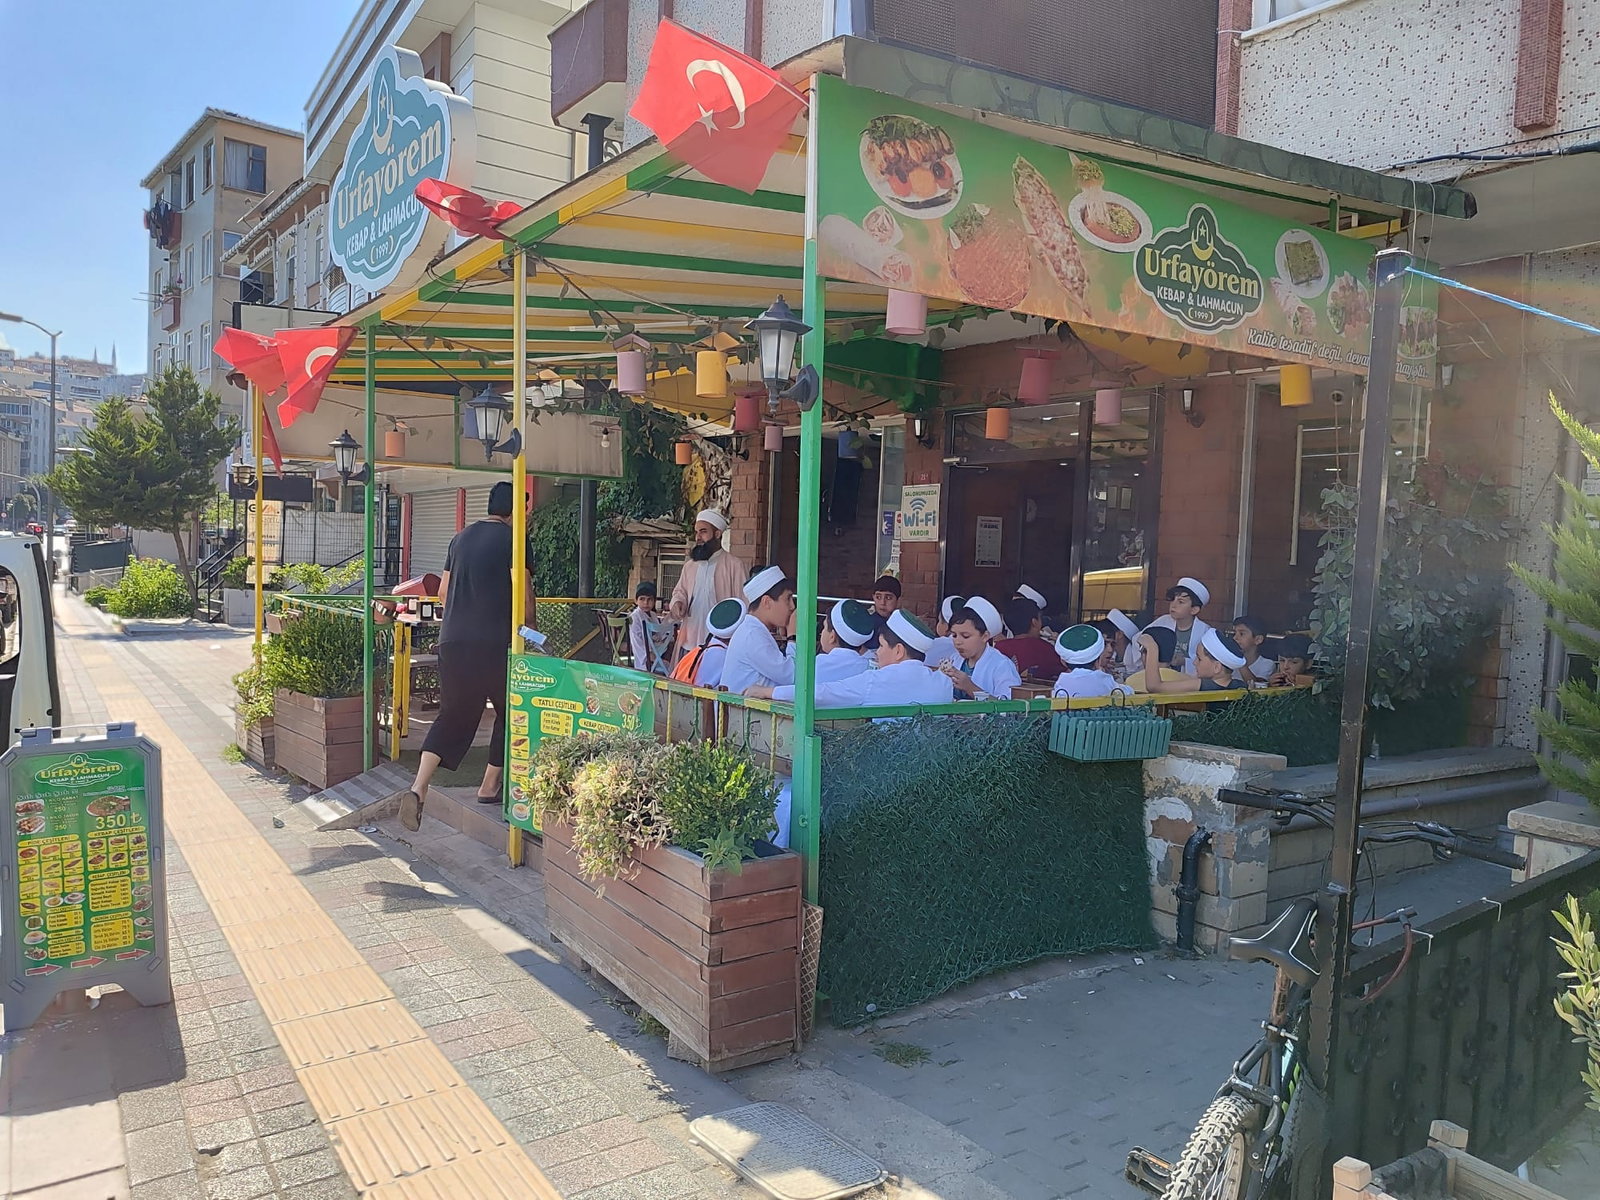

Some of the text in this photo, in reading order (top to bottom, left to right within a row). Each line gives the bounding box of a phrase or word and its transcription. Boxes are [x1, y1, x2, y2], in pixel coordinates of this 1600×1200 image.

[337, 119, 442, 230] Urfayörem
[346, 227, 368, 258] KEBAP
[370, 225, 376, 239] &
[1144, 247, 1259, 299] Urfayörem
[1157, 285, 1244, 316] KEBAP & LAHMACUN
[1247, 328, 1278, 349] Kalite
[1278, 335, 1317, 360] tesadüf
[1318, 344, 1343, 364] değil,
[1345, 350, 1370, 368] deva
[905, 489, 937, 497] SALONUMUZDA
[904, 510, 936, 527] Wi-Fi
[538, 698, 554, 708] TATLI
[40, 764, 120, 779] Urfayörem
[95, 813, 126, 829] 350
